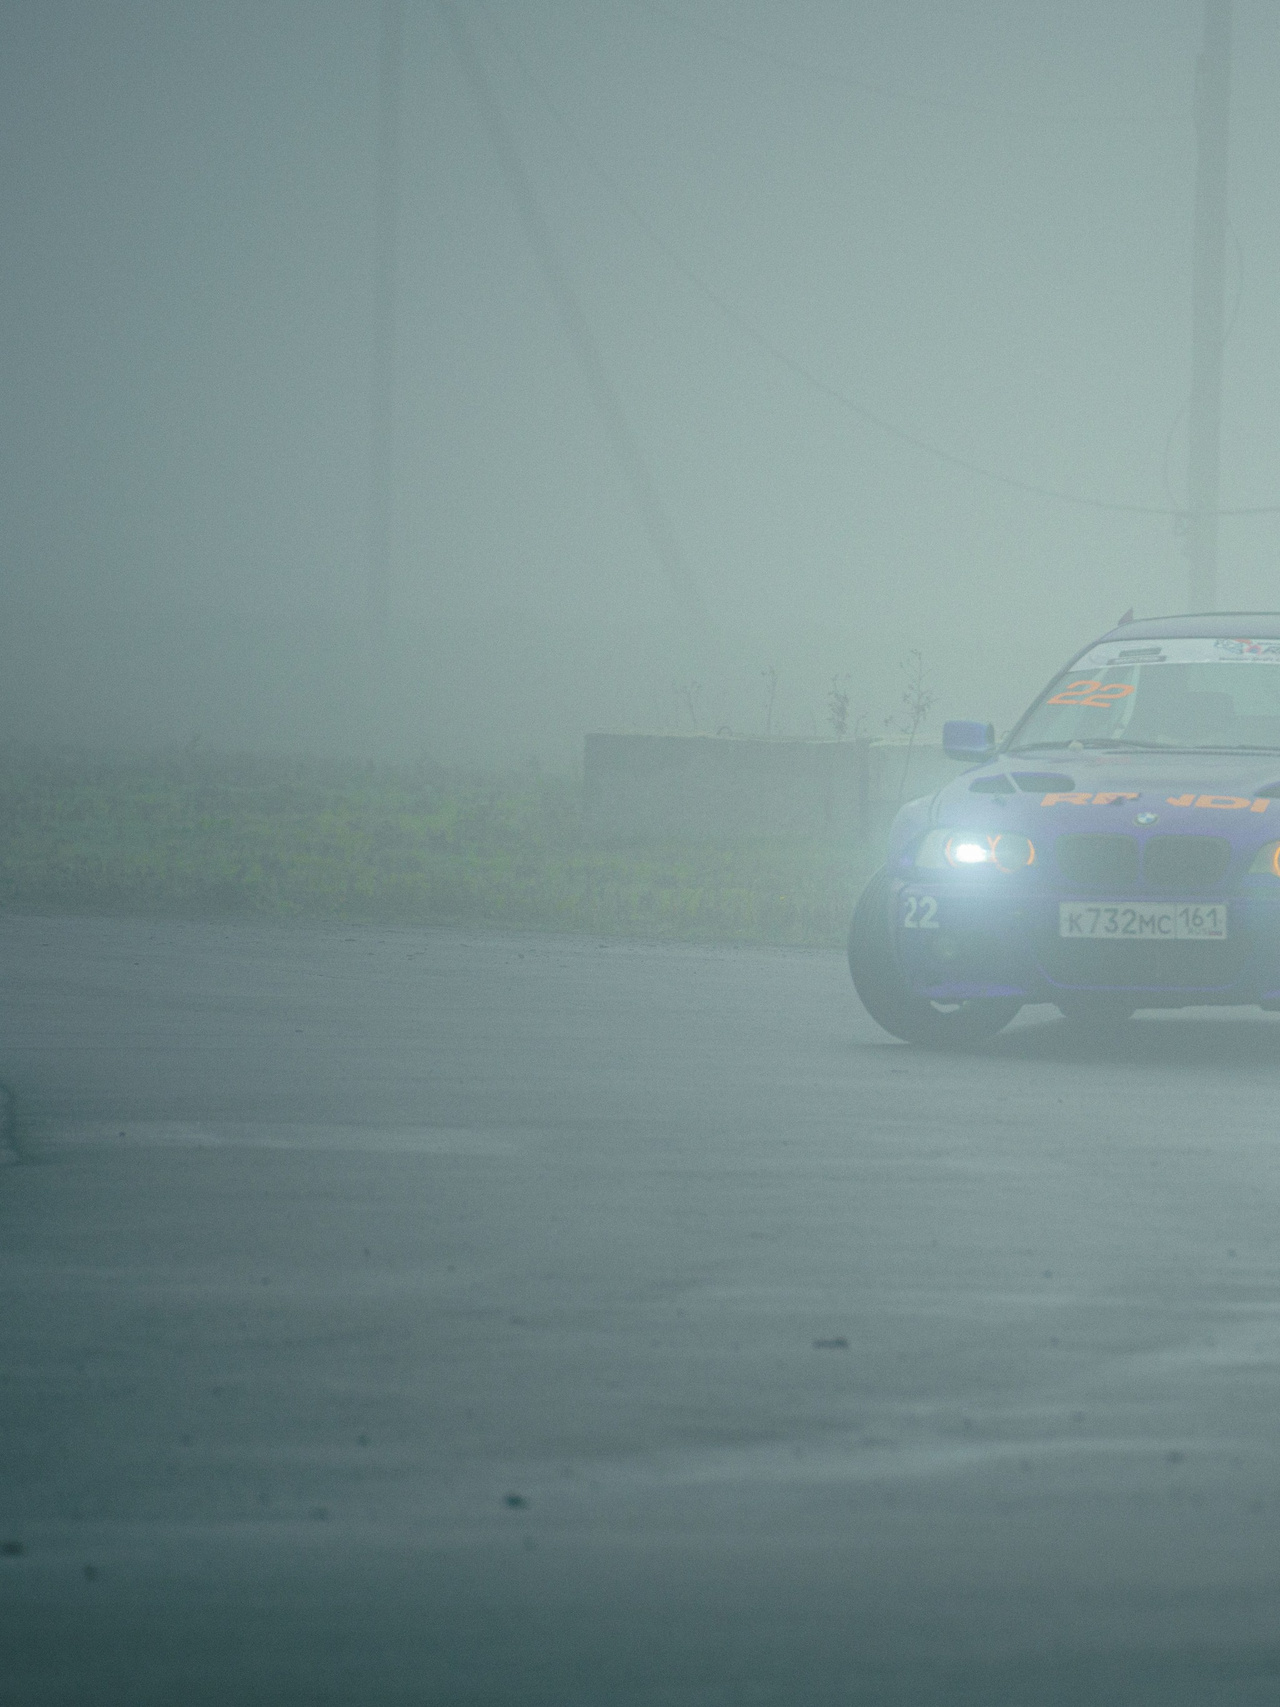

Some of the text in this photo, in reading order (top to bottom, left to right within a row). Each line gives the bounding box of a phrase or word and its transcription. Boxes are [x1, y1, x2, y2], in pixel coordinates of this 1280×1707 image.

[1047, 679, 1134, 708] 22
[1040, 792, 1270, 813] RDI
[904, 895, 940, 929] 22
[1179, 907, 1218, 928] 161
